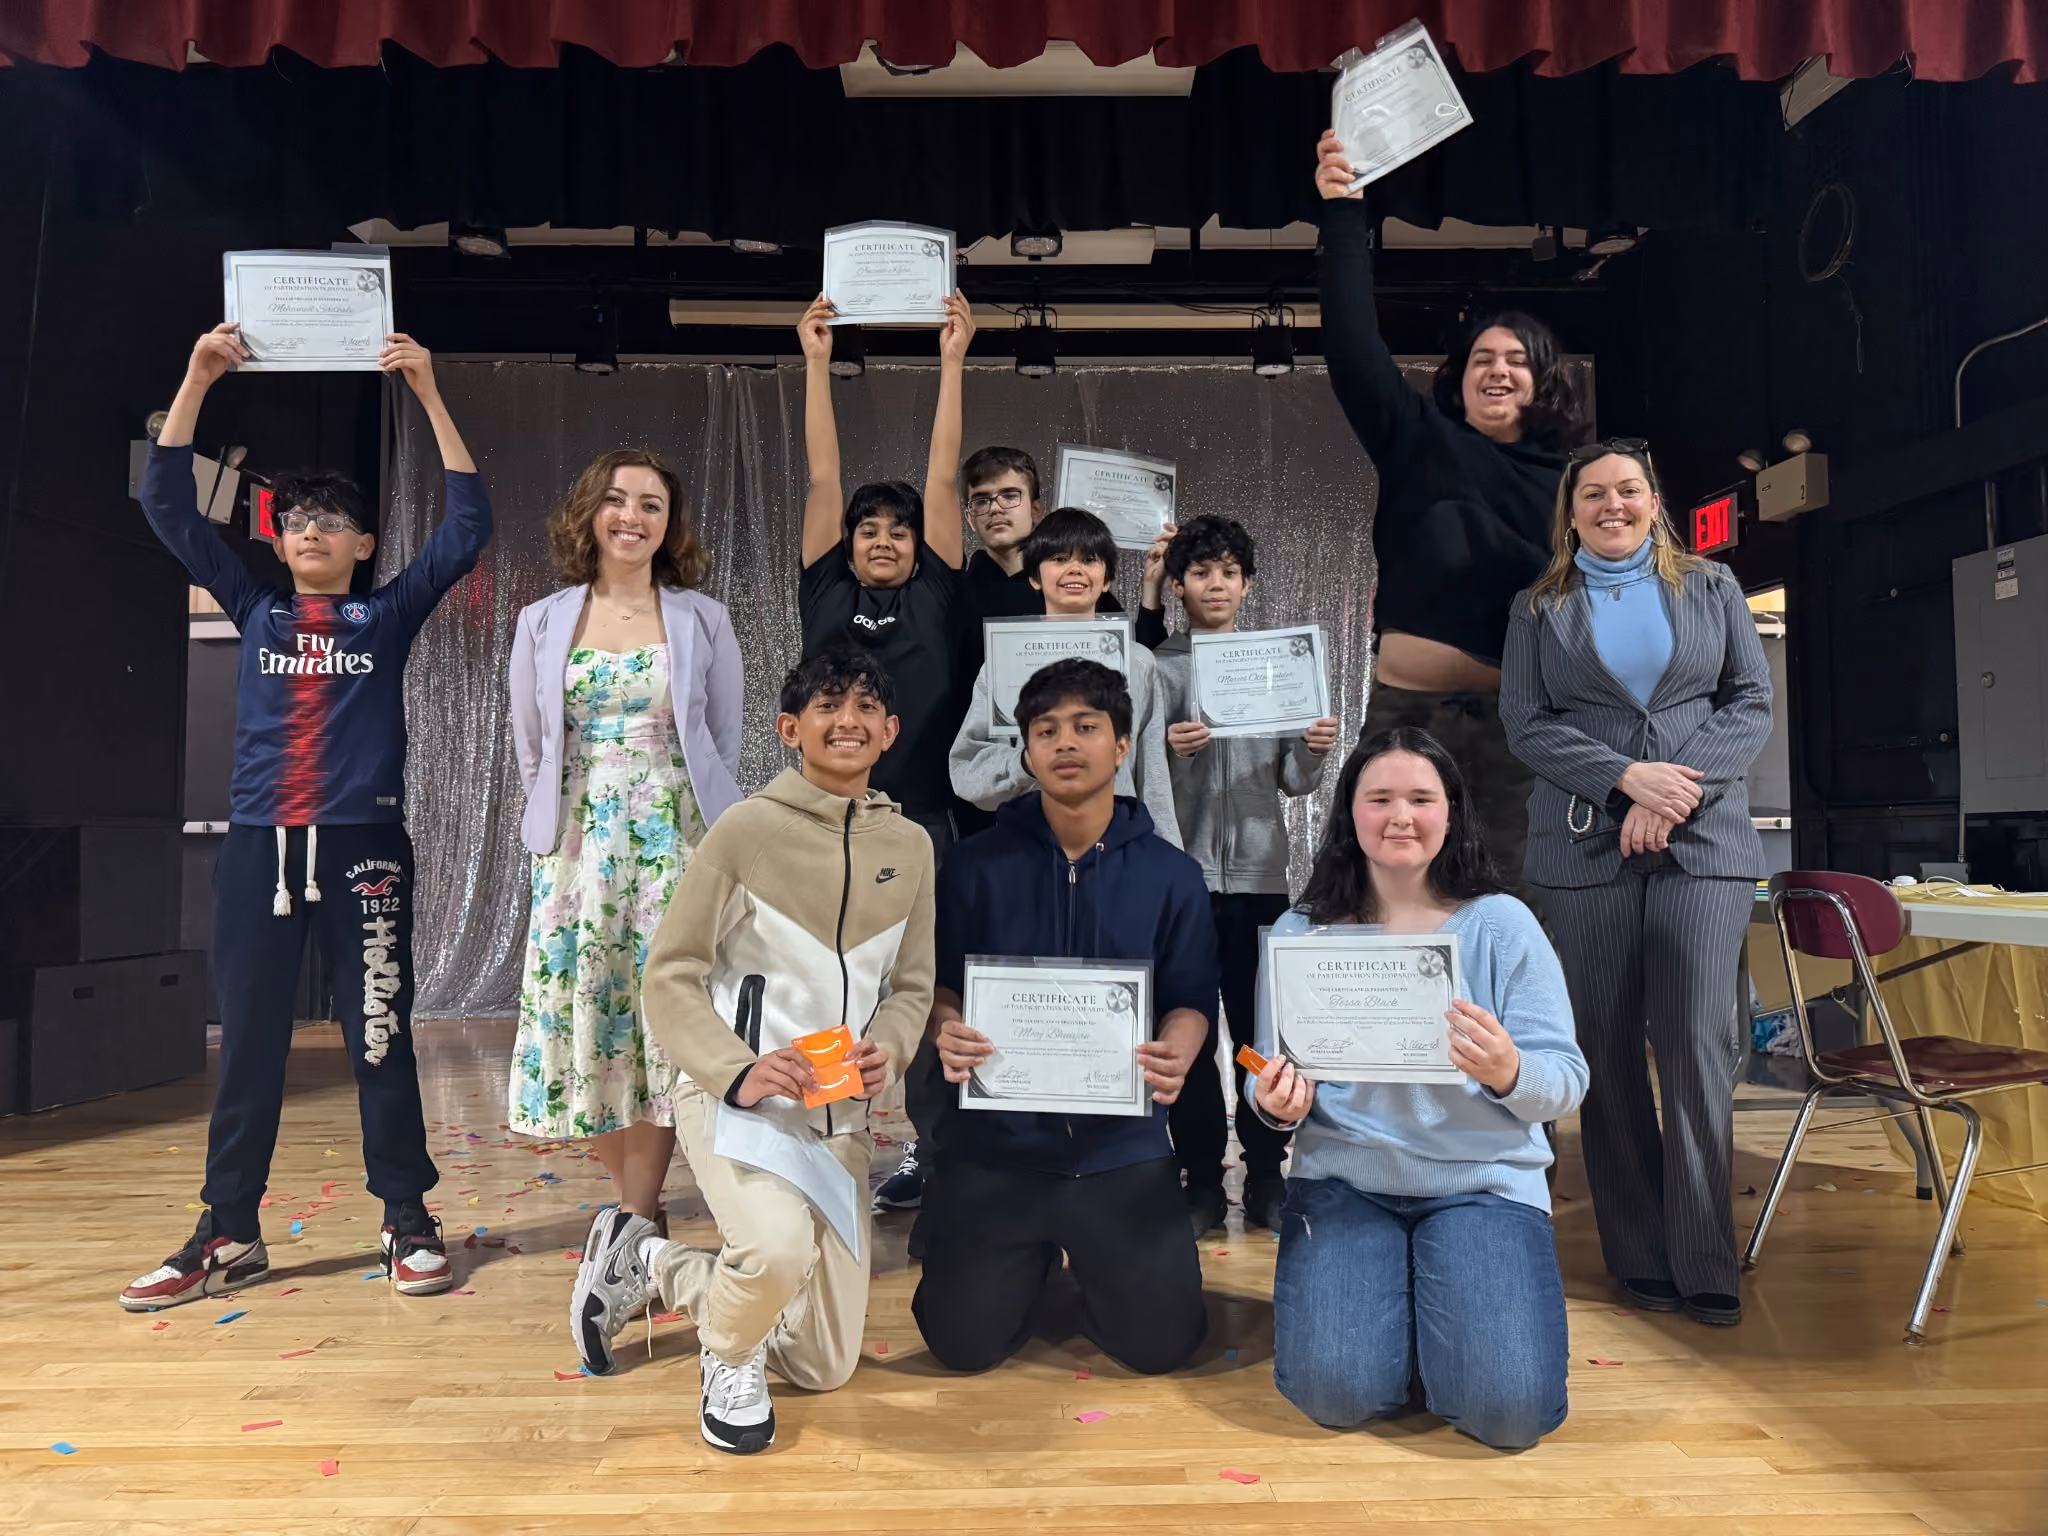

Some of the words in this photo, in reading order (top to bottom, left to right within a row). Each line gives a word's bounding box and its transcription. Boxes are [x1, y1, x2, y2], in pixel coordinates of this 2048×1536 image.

[273, 276, 349, 286] CERTIFICATE
[1695, 497, 1731, 552] EXIT
[296, 633, 335, 655] Fly
[1024, 641, 1093, 651] CERTIFICATE
[1222, 647, 1282, 659] CERTIFICATE
[259, 648, 374, 674] Emirates
[345, 859, 403, 879] CALIFORNIA
[880, 868, 896, 877] NIKE
[360, 897, 400, 914] 1922
[1316, 961, 1407, 972] CERTIFICATE
[1011, 993, 1097, 1005] CERTIFICATE
